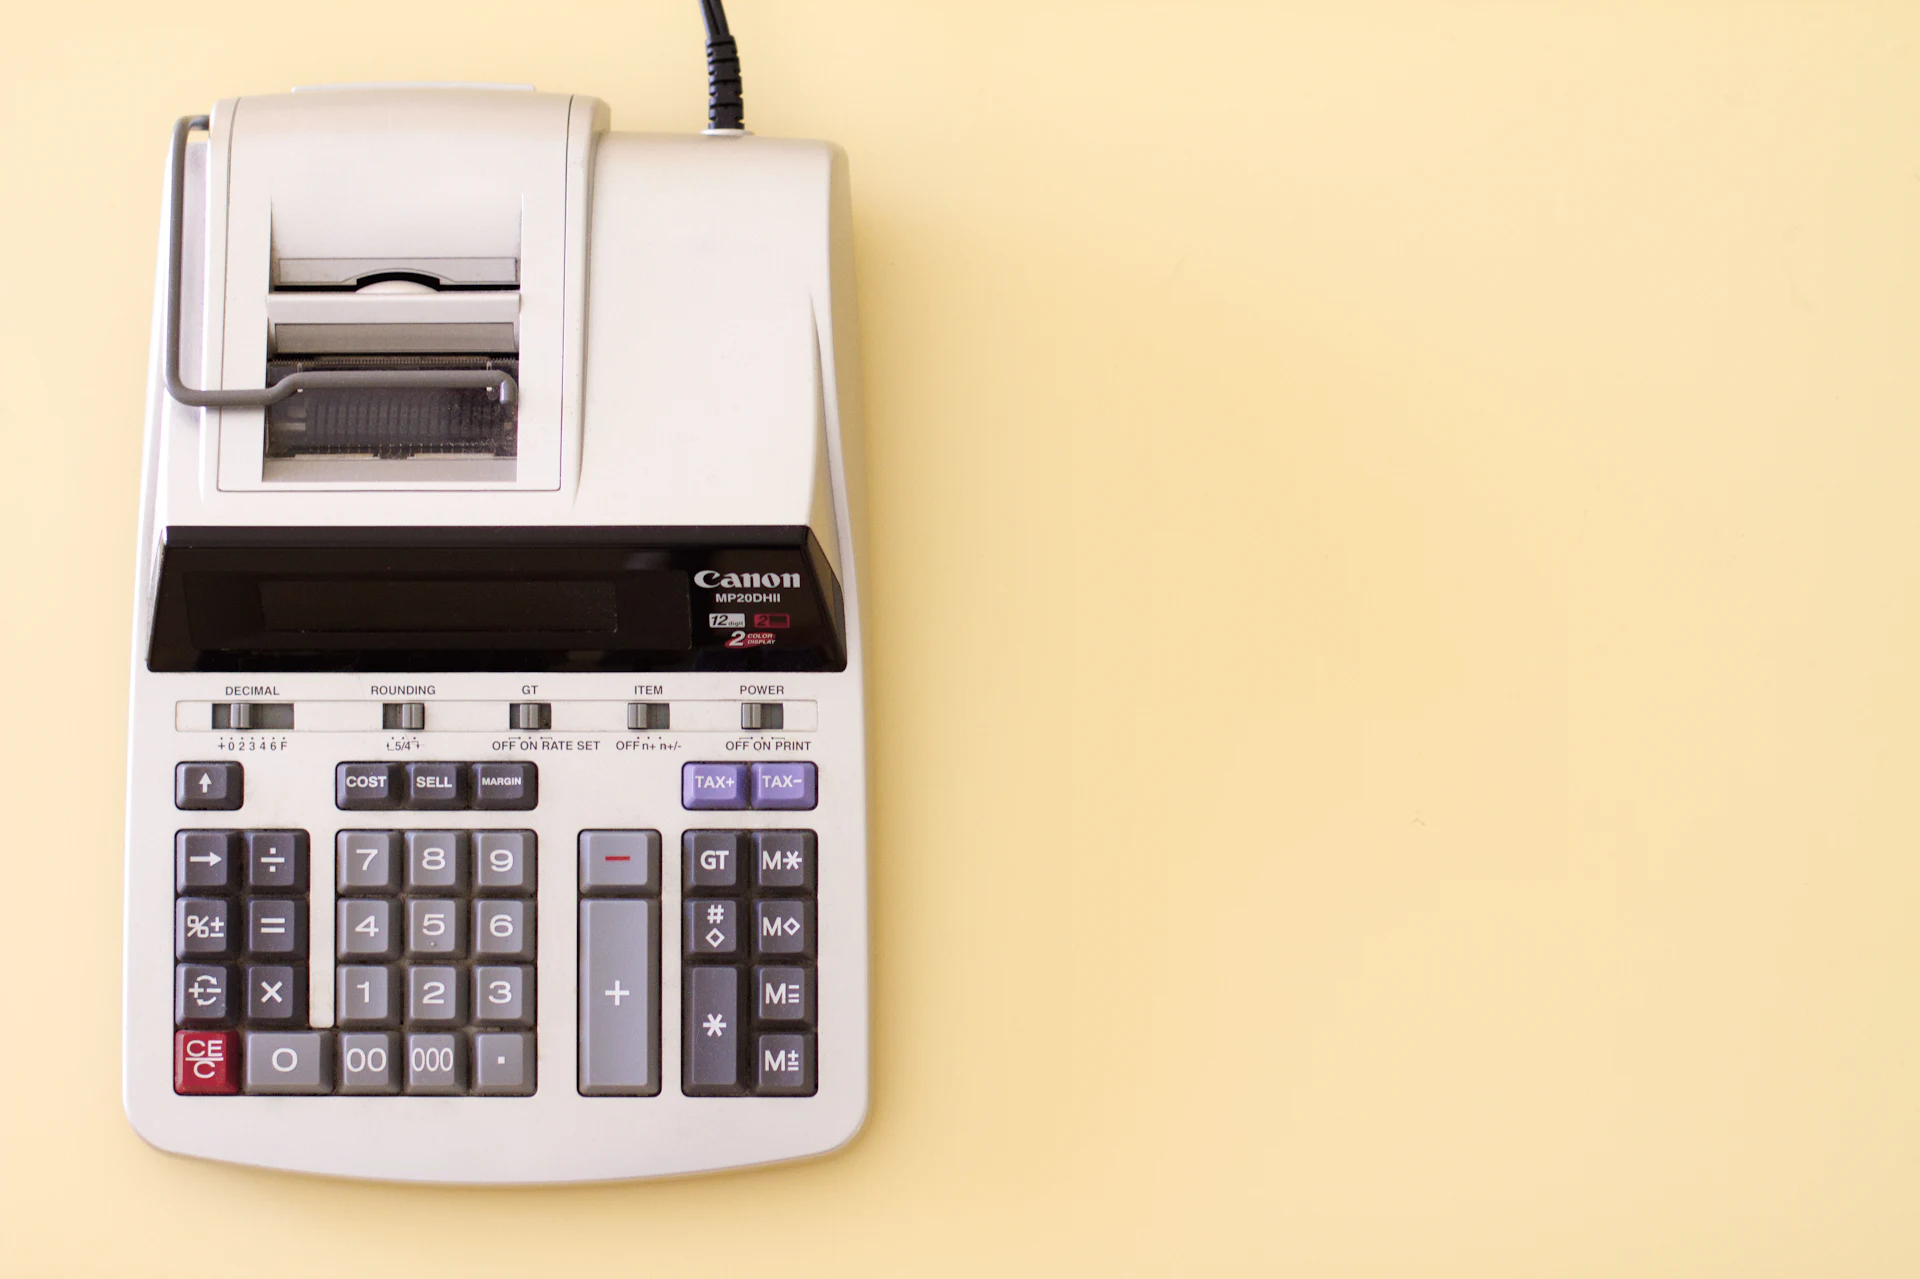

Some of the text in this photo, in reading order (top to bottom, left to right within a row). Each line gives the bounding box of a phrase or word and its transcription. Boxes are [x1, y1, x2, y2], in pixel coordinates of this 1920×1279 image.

[694, 569, 800, 588] Canon
[716, 593, 780, 603] MP20DHII
[711, 614, 744, 628] 12 digit
[729, 630, 746, 646] 2
[225, 686, 280, 696] DECIMAL
[371, 685, 436, 696] ROUNDING
[522, 685, 538, 695] GT
[634, 685, 663, 695] ITEM
[740, 685, 784, 695] POWER
[228, 741, 235, 751] 0
[238, 741, 246, 751] 2
[249, 741, 256, 751] 3
[259, 741, 266, 751] 4
[270, 741, 277, 751] 6
[280, 741, 288, 751] F
[492, 741, 600, 751] OFF ON RATE SET
[616, 741, 639, 751] OFF
[726, 741, 812, 751] OFF ON PRINT
[346, 776, 386, 788] COST
[416, 776, 452, 788] SELL
[482, 777, 522, 786] MARGIN
[695, 776, 734, 788] TAX+
[356, 849, 378, 870] 7
[421, 848, 446, 870] 8
[490, 849, 514, 872] 9
[700, 850, 729, 870] GT
[355, 916, 379, 937] 4
[422, 914, 445, 936] 5
[490, 915, 514, 937] 6
[357, 981, 370, 1003] 1
[422, 982, 445, 1004] 2
[489, 981, 512, 1003] 3
[186, 1040, 223, 1056] CE
[346, 1048, 387, 1072] 00
[412, 1048, 453, 1072] 000
[193, 1060, 216, 1079] C
